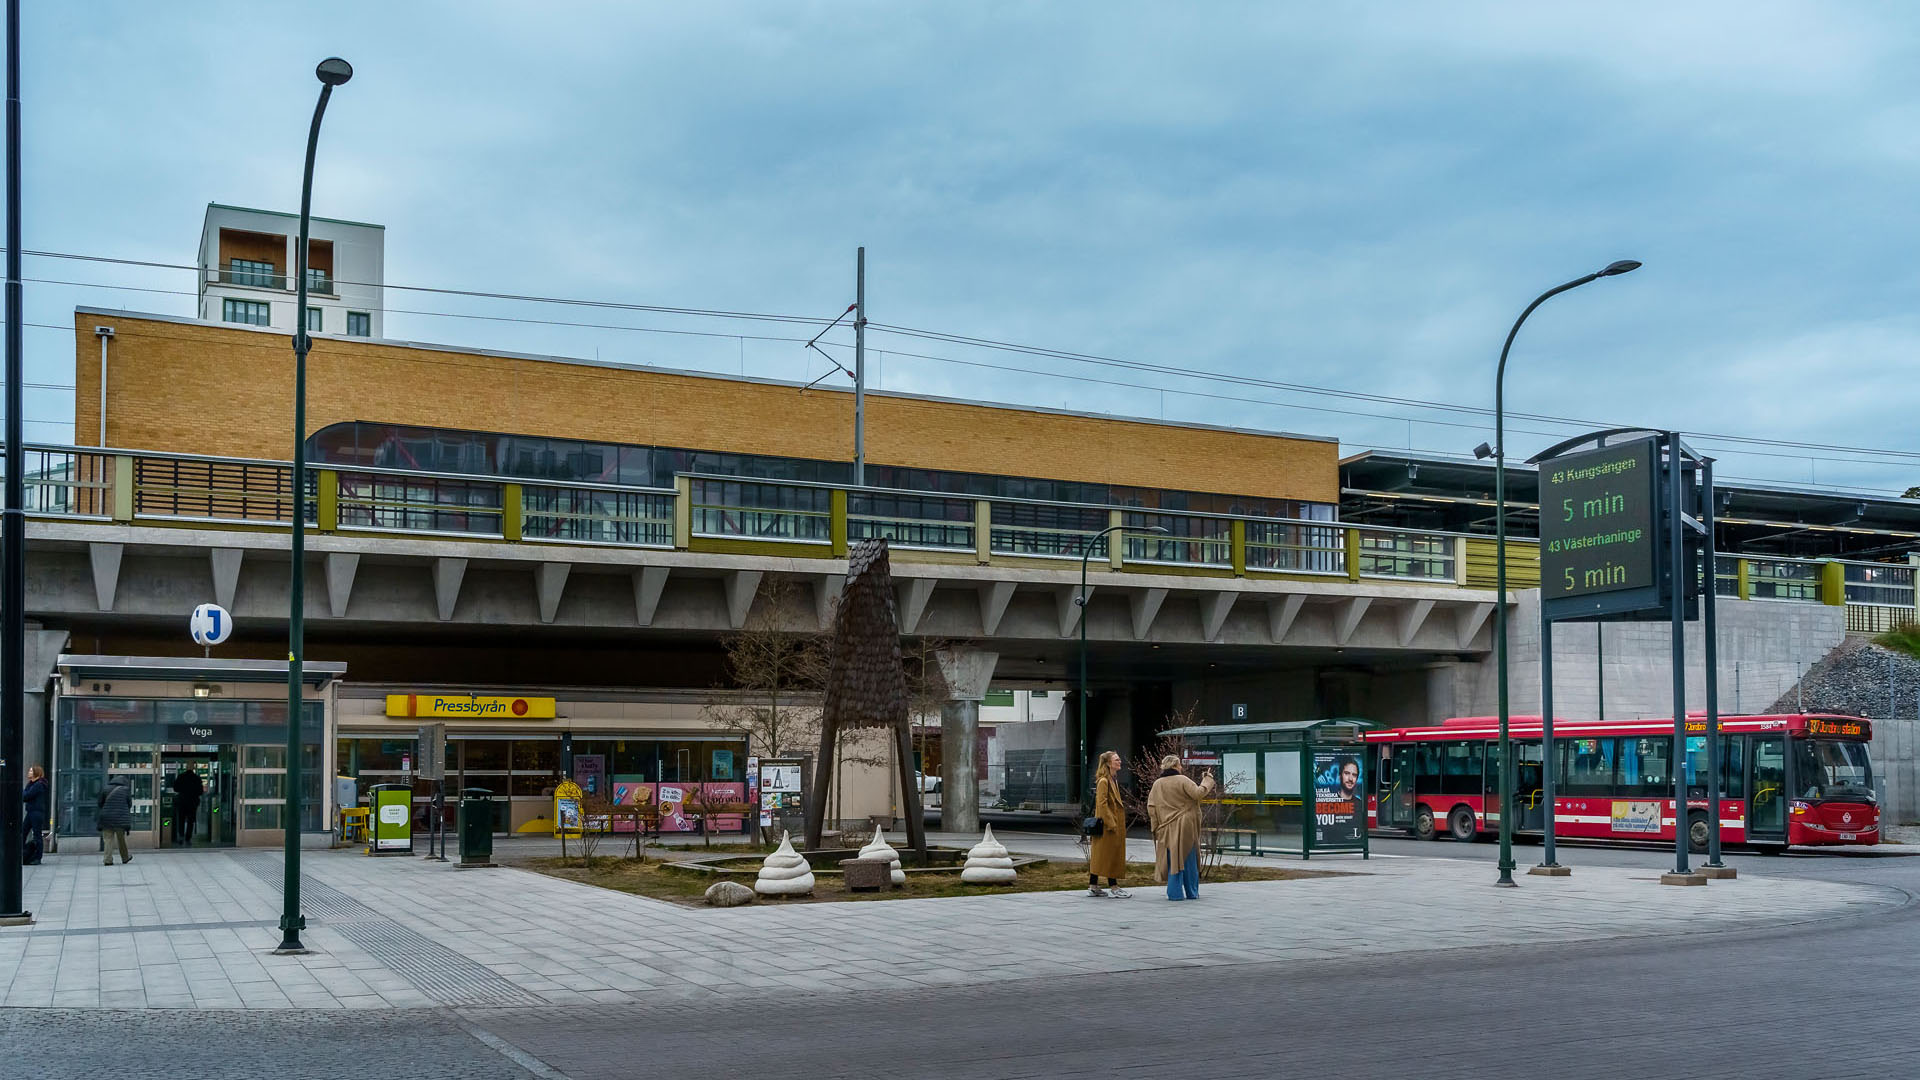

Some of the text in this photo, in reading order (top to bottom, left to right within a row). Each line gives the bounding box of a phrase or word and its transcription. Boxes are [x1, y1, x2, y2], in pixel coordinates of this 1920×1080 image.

[1551, 458, 1637, 484] 43 Kungsängen
[1563, 491, 1624, 522] 5 min
[1548, 529, 1642, 552] 43 Västerhaninge
[1565, 561, 1626, 590] 5 min
[205, 609, 221, 641] J
[434, 698, 507, 715] Pressbyrån
[1237, 706, 1244, 717] B
[190, 727, 213, 738] Vega
[1316, 803, 1354, 814] BECOME
[1316, 814, 1335, 825] YOU
